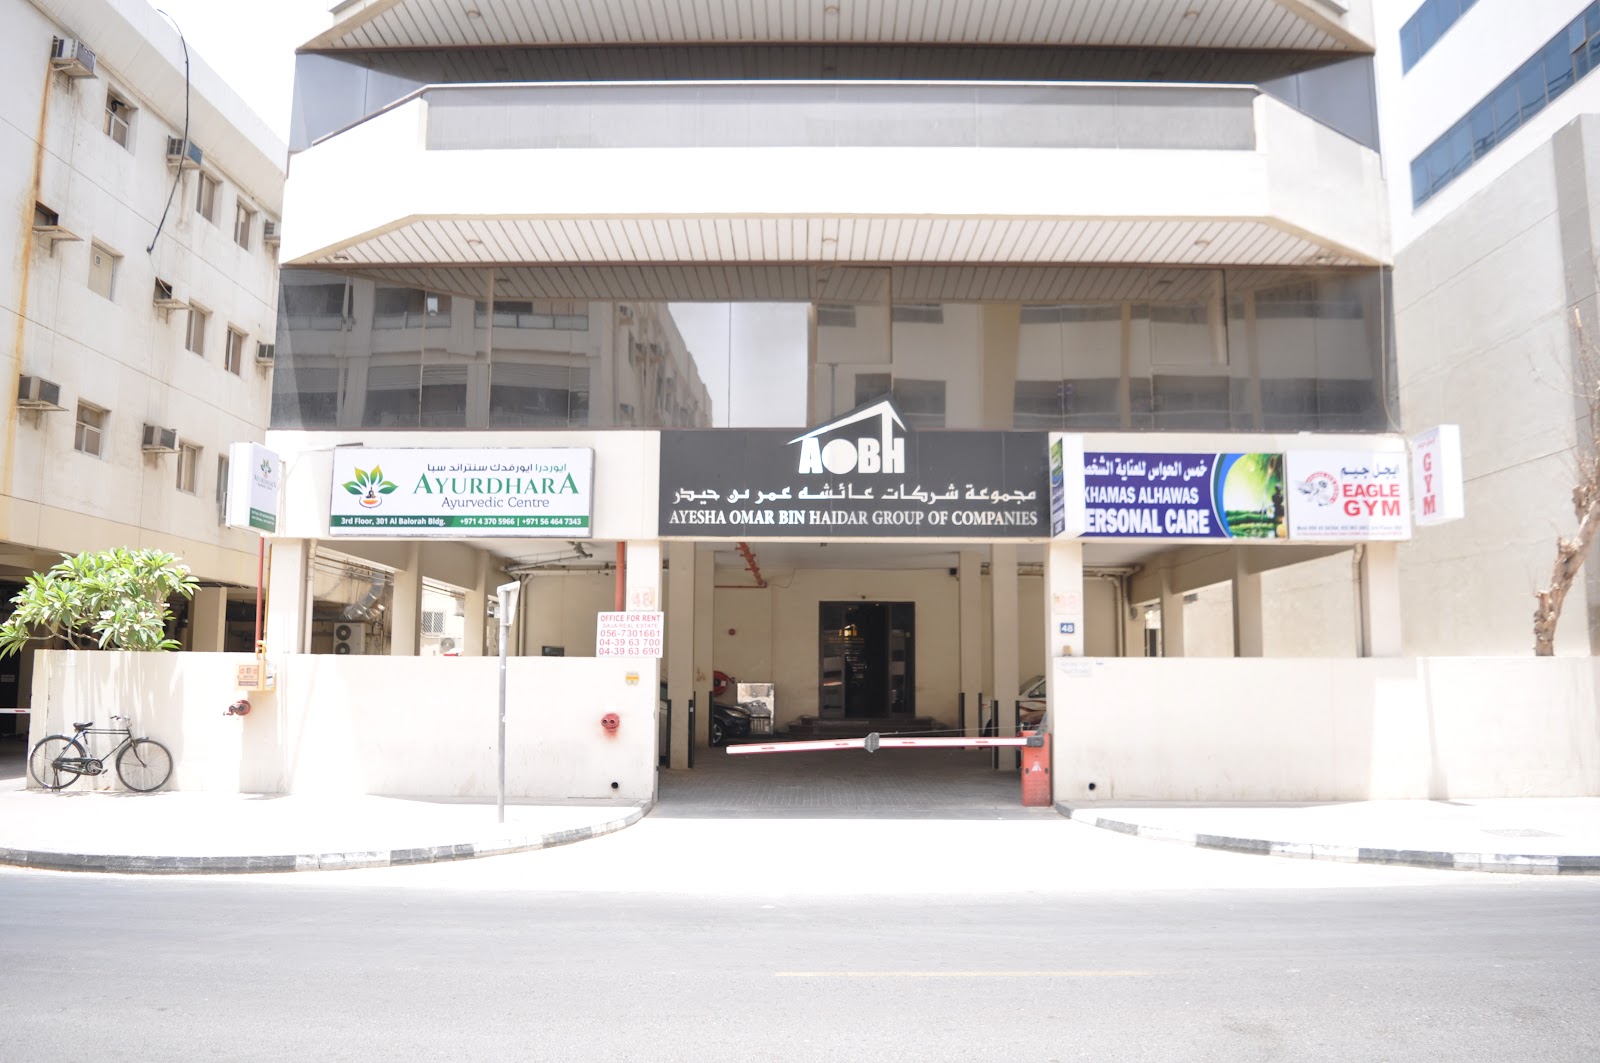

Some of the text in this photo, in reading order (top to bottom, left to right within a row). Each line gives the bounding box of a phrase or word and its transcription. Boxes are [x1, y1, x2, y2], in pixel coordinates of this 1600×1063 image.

[798, 437, 905, 475] AOBH
[1115, 458, 1146, 481] للعناية
[1183, 459, 1208, 481] خمس
[413, 472, 580, 494] AYURDHARA
[1343, 484, 1400, 497] EAGLE
[1423, 453, 1436, 515] GYM
[672, 487, 720, 505] حيدر
[754, 486, 793, 504] عمر
[881, 483, 959, 504] شركات
[965, 484, 1036, 504] مجموعة
[1138, 486, 1199, 504] ALHAWAS
[441, 496, 549, 510] Ayurvedic Centre
[1344, 500, 1400, 516] GYM
[340, 517, 353, 525] 3rd
[354, 517, 374, 526] Floor,
[376, 517, 388, 525] 301
[389, 517, 397, 525] Al
[398, 517, 427, 525] Balorah
[428, 517, 446, 527] Bldg.
[460, 517, 476, 525] +971
[477, 517, 483, 525] 4
[483, 517, 497, 525] 370
[498, 517, 515, 525] 5966
[522, 517, 539, 525] +971
[540, 517, 549, 525] 56
[550, 517, 563, 525] 464
[564, 517, 582, 525] 7343
[669, 510, 1038, 525] AYESHA OMAR BIN HAIDAR GROUP OF COMPANIES
[1085, 508, 1210, 533] ERSONAL CARE
[600, 630, 661, 638] 056-7301661
[1061, 624, 1074, 633] 48
[598, 647, 660, 656] 04-39 63 690
